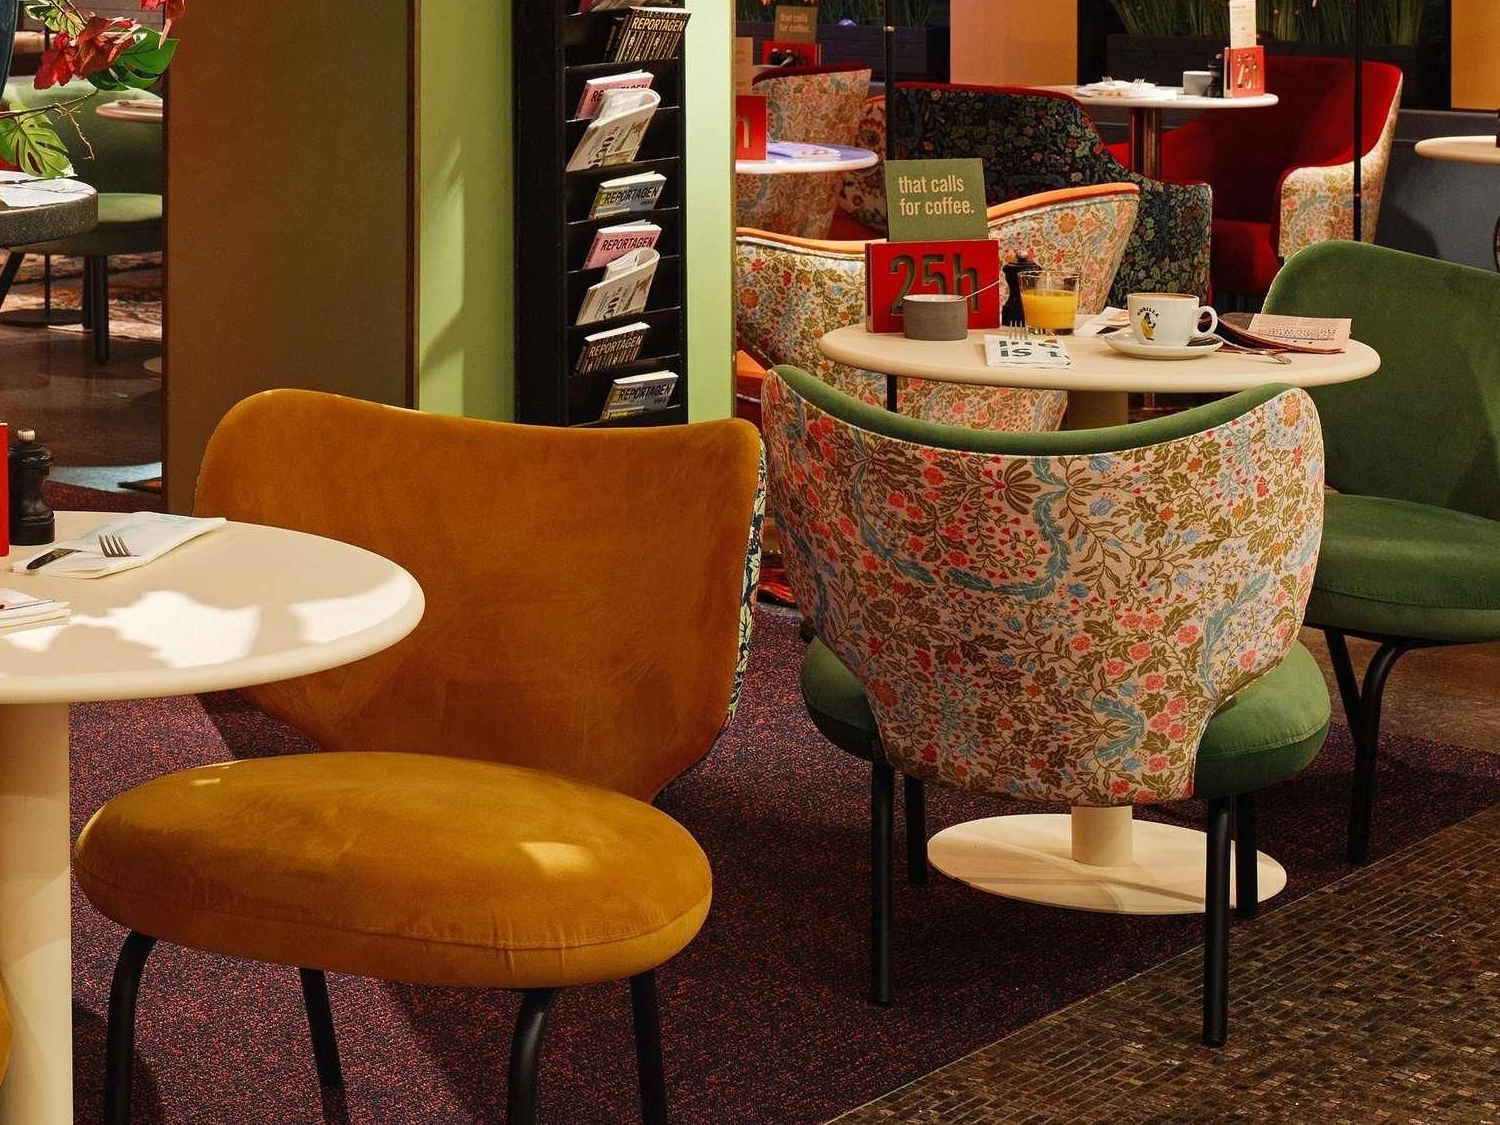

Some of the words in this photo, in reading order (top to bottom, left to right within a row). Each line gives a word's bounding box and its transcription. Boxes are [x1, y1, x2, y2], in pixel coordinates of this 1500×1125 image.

[631, 17, 685, 32] REPORTAGEN
[898, 176, 928, 194] that
[930, 174, 965, 193] calls
[604, 186, 660, 204] REPORTAGEN
[899, 197, 921, 216] for
[925, 196, 975, 215] coffee.
[600, 236, 655, 252] REPORTAGEN
[889, 253, 981, 316] 25h
[588, 335, 644, 358] REPORTAGEN
[618, 383, 673, 403] REPORTAGEN
